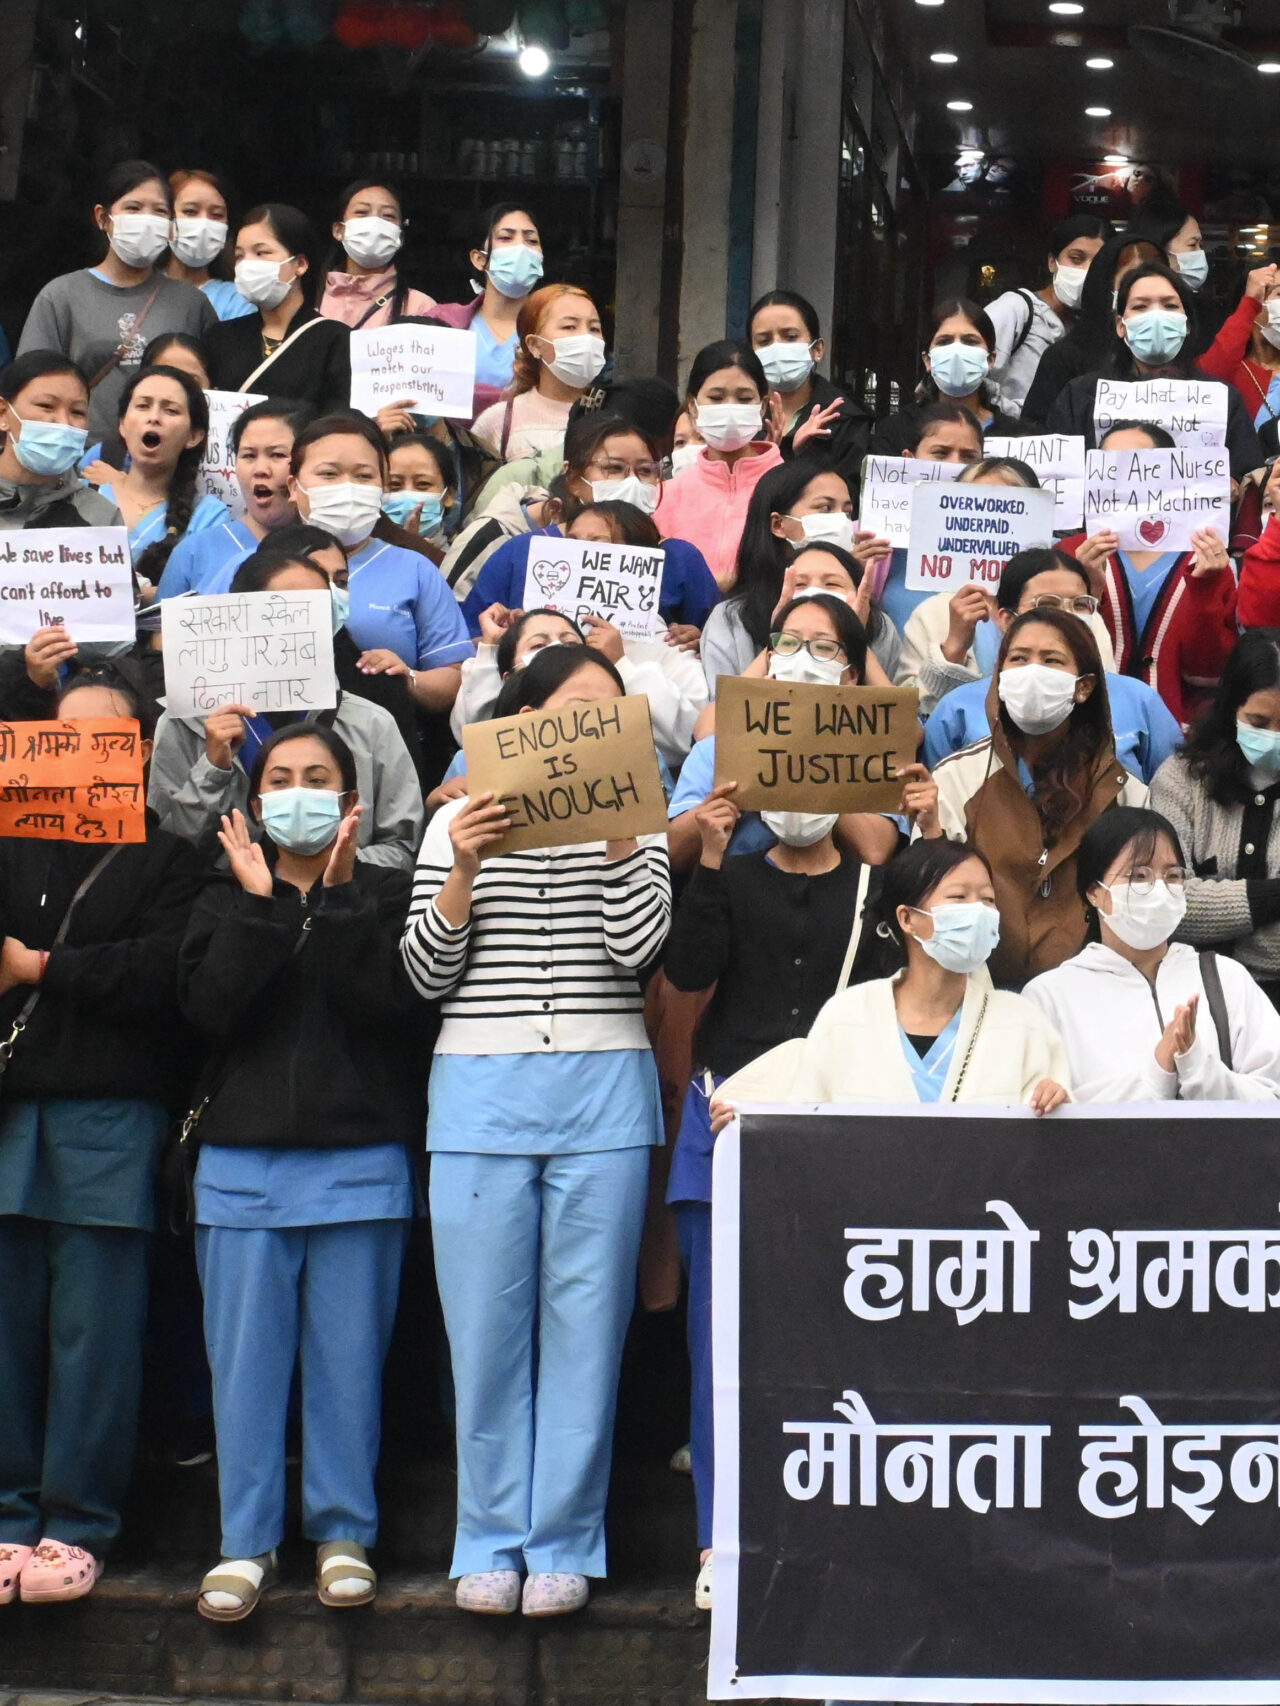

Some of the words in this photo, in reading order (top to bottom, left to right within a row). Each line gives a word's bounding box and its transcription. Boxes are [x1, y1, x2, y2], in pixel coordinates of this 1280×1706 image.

[367, 341, 404, 363] Wages
[410, 340, 435, 356] that
[371, 362, 404, 375] match
[411, 364, 433, 375] our
[1098, 381, 1128, 410] Pay
[1135, 382, 1176, 404] What
[1188, 384, 1213, 405] We
[1171, 414, 1201, 432] Not
[1008, 438, 1070, 464] WANT
[869, 458, 908, 485] Not
[1088, 453, 1118, 481] We
[1128, 452, 1161, 482] Are
[1171, 451, 1226, 481] Nurse
[872, 487, 909, 511] have
[1087, 489, 1120, 514] Not
[1125, 490, 1139, 512] A
[1147, 486, 1223, 512] Machine
[884, 513, 911, 534] hav
[23, 548, 54, 563] save
[58, 544, 93, 564] lives
[99, 544, 124, 565] but
[581, 550, 612, 571] WE
[620, 554, 664, 578] WANT
[920, 555, 952, 578] NO
[970, 558, 1006, 581] MO
[40, 580, 90, 600] afford
[95, 580, 113, 599] to
[576, 576, 634, 611] FAIR
[180, 594, 253, 636] सरकारी
[496, 704, 621, 759] ENOUGH
[745, 699, 792, 736] WE
[815, 702, 897, 736] WANT
[543, 753, 578, 779] IS
[757, 748, 899, 788] JUSTICE
[497, 771, 640, 830] ENOUGH
[843, 1200, 1040, 1326] हाम्रो
[782, 1390, 1051, 1514] मौनता
